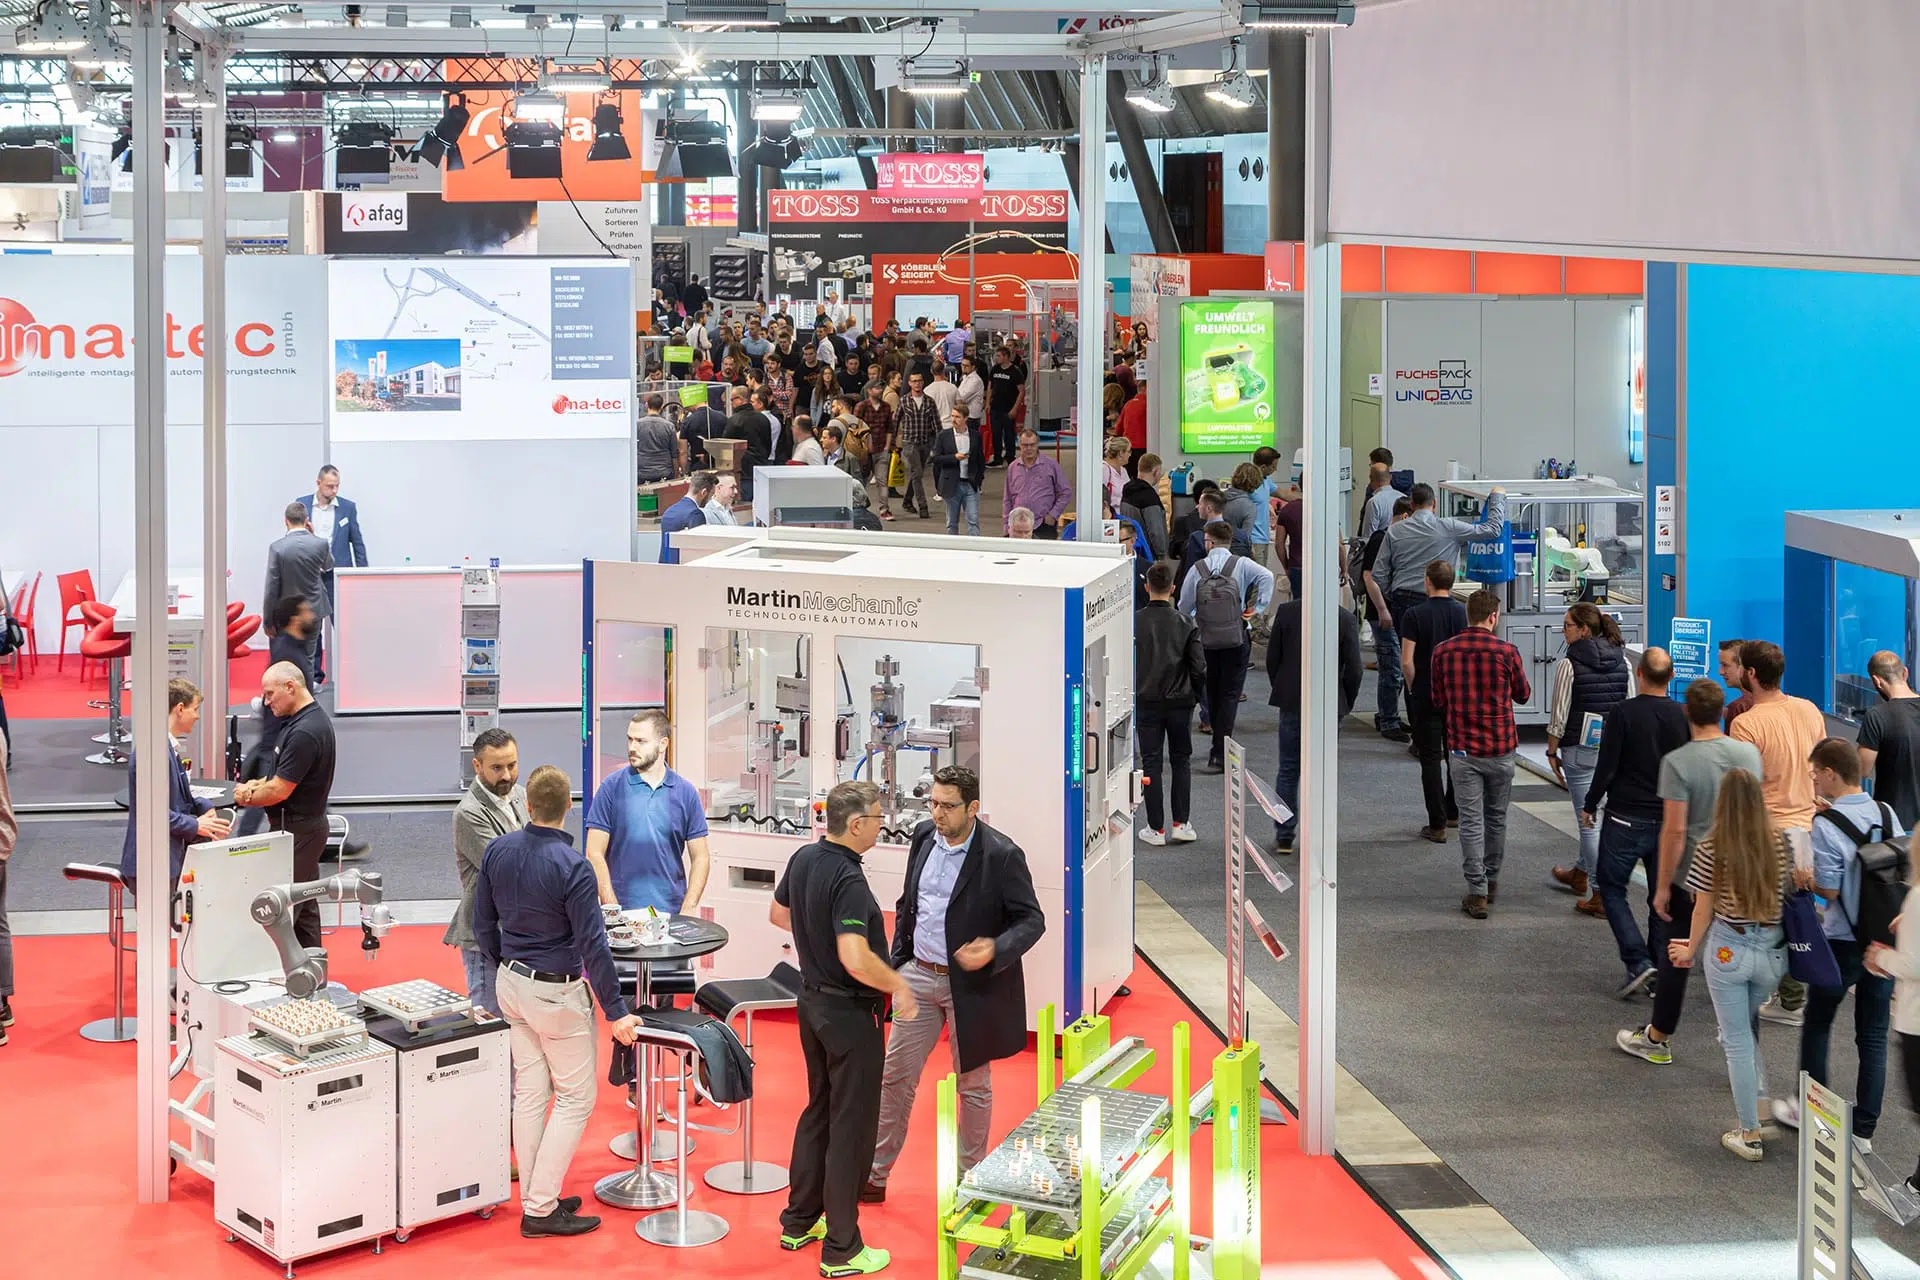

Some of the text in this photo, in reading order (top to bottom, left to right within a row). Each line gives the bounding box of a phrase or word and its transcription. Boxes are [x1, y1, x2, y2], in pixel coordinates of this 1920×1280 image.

[898, 162, 980, 184] TOSS
[772, 194, 1065, 217] TOSS TOSS
[871, 196, 890, 204] TOSS
[368, 203, 403, 225] afag
[892, 206, 947, 214] GmbH & Co. KG
[609, 230, 634, 238] Prüfen
[1205, 312, 1256, 323] UMWELT
[282, 311, 296, 358] gmbh
[1194, 324, 1265, 335] FREUNDLICH
[27, 369, 86, 378] intelligente
[1395, 369, 1472, 379] FUCHSPACK
[1395, 389, 1472, 402] UNIQBAG
